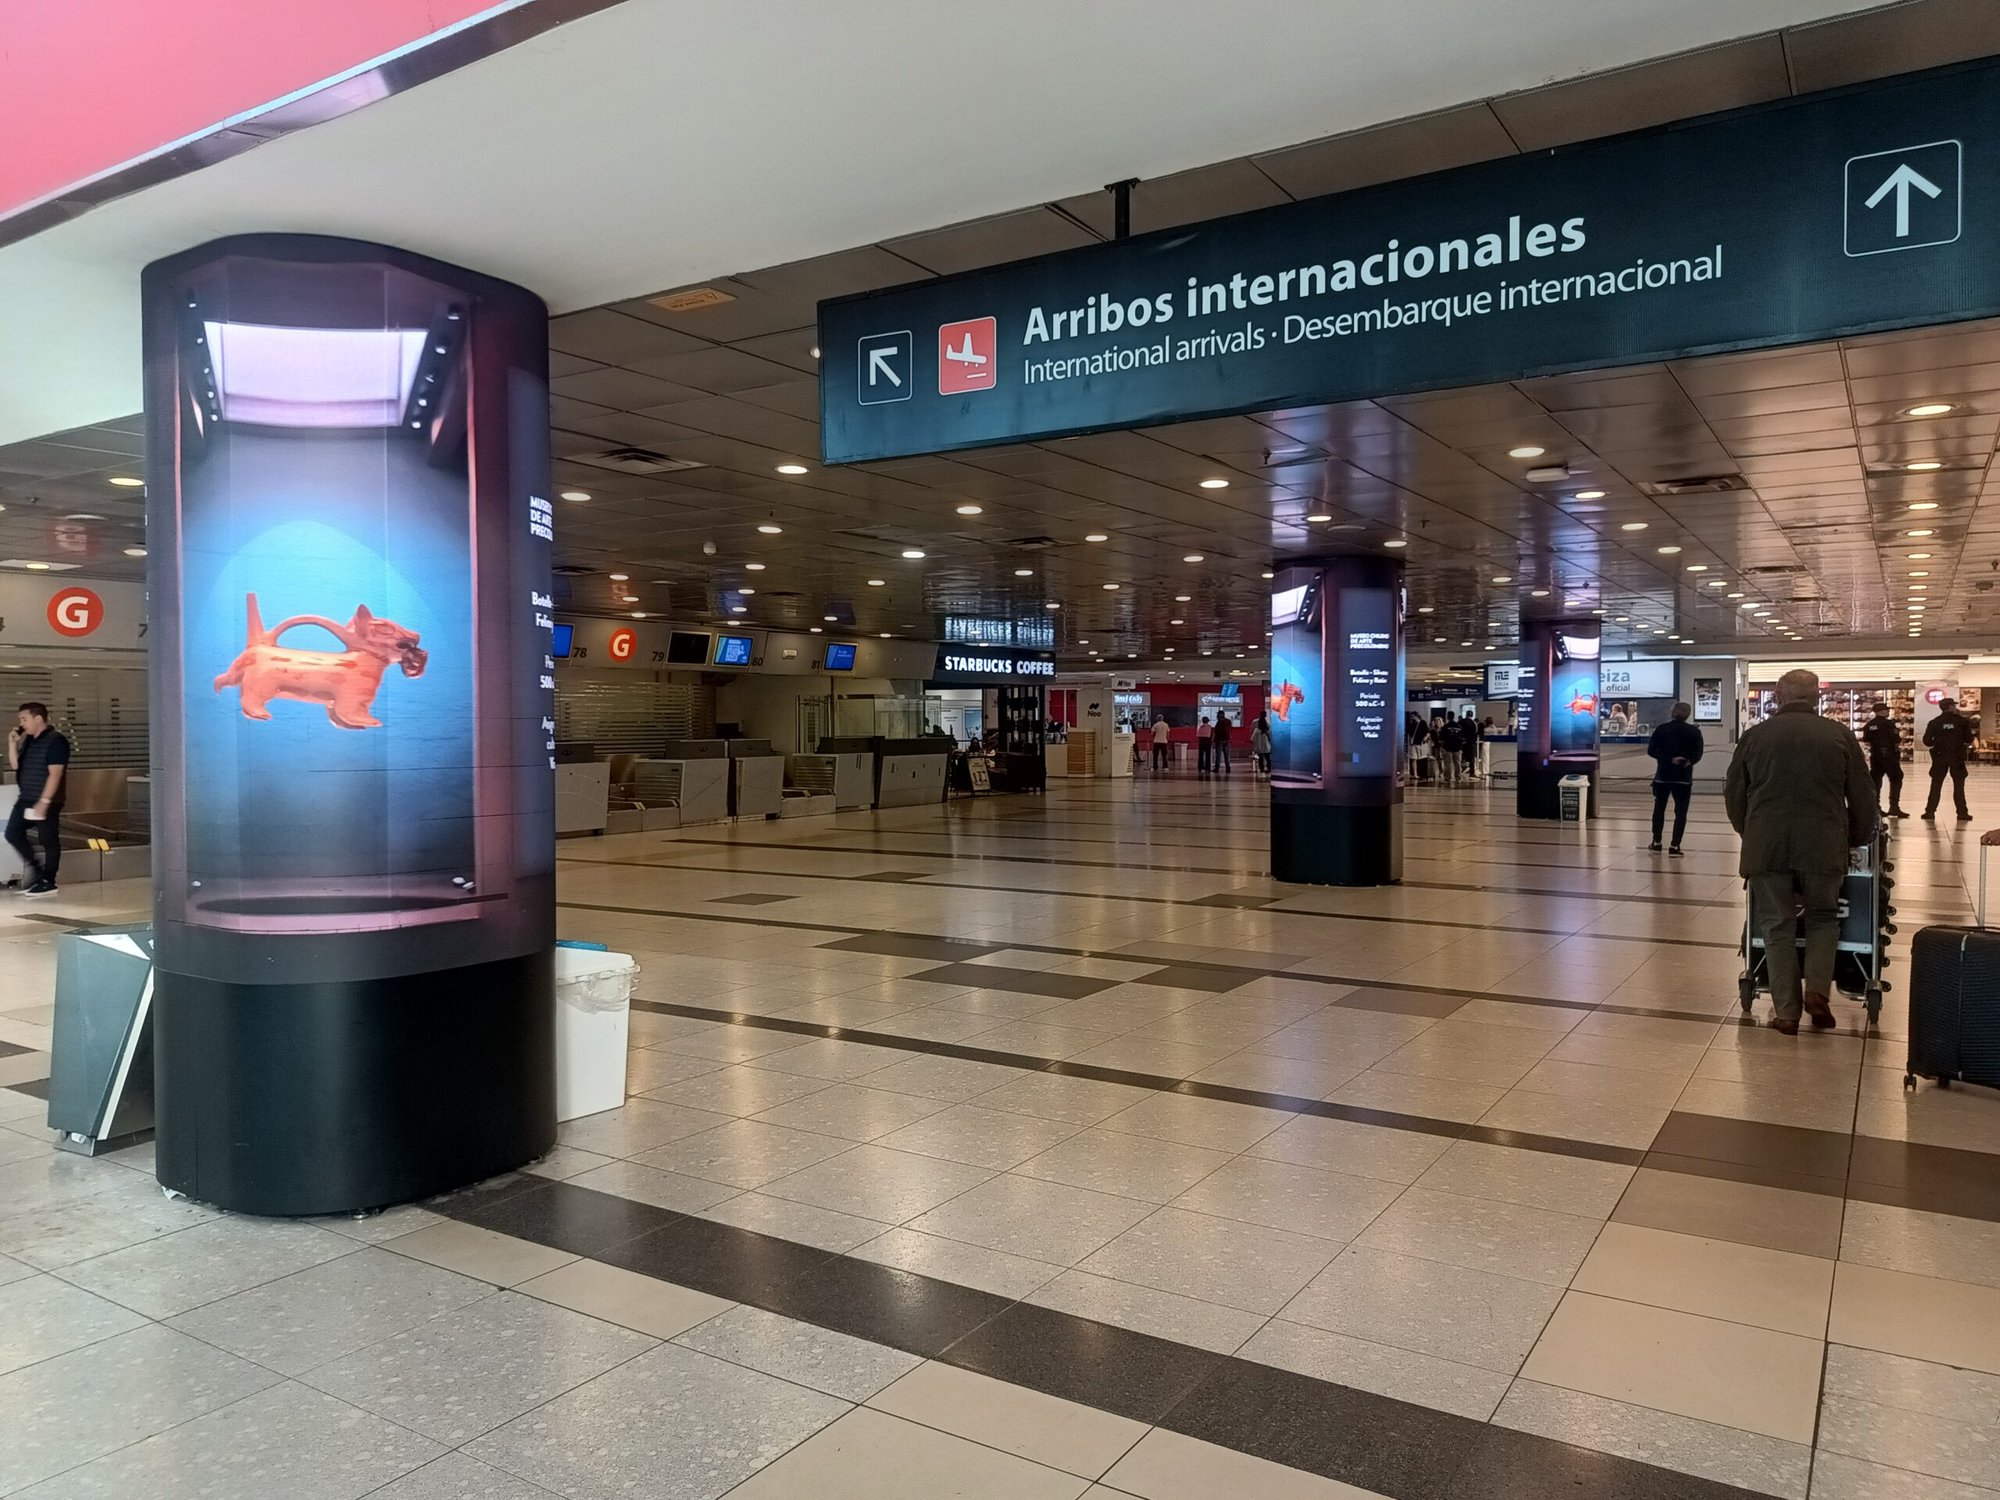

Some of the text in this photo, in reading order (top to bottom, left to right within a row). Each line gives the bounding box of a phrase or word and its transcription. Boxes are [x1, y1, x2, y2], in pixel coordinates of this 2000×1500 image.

[1023, 215, 1586, 345] Arribos internacionales
[1024, 335, 1170, 384] International
[1175, 321, 1265, 361] arrivals
[1284, 290, 1492, 343] Desembarque
[1500, 244, 1722, 311] internacional
[57, 596, 89, 629] G
[573, 647, 587, 658] 78
[613, 633, 631, 657] G
[652, 651, 664, 661] 79
[811, 660, 820, 669] 81
[945, 655, 1054, 675] STARBUCKS COFFEE
[1606, 683, 1630, 691] oficial
